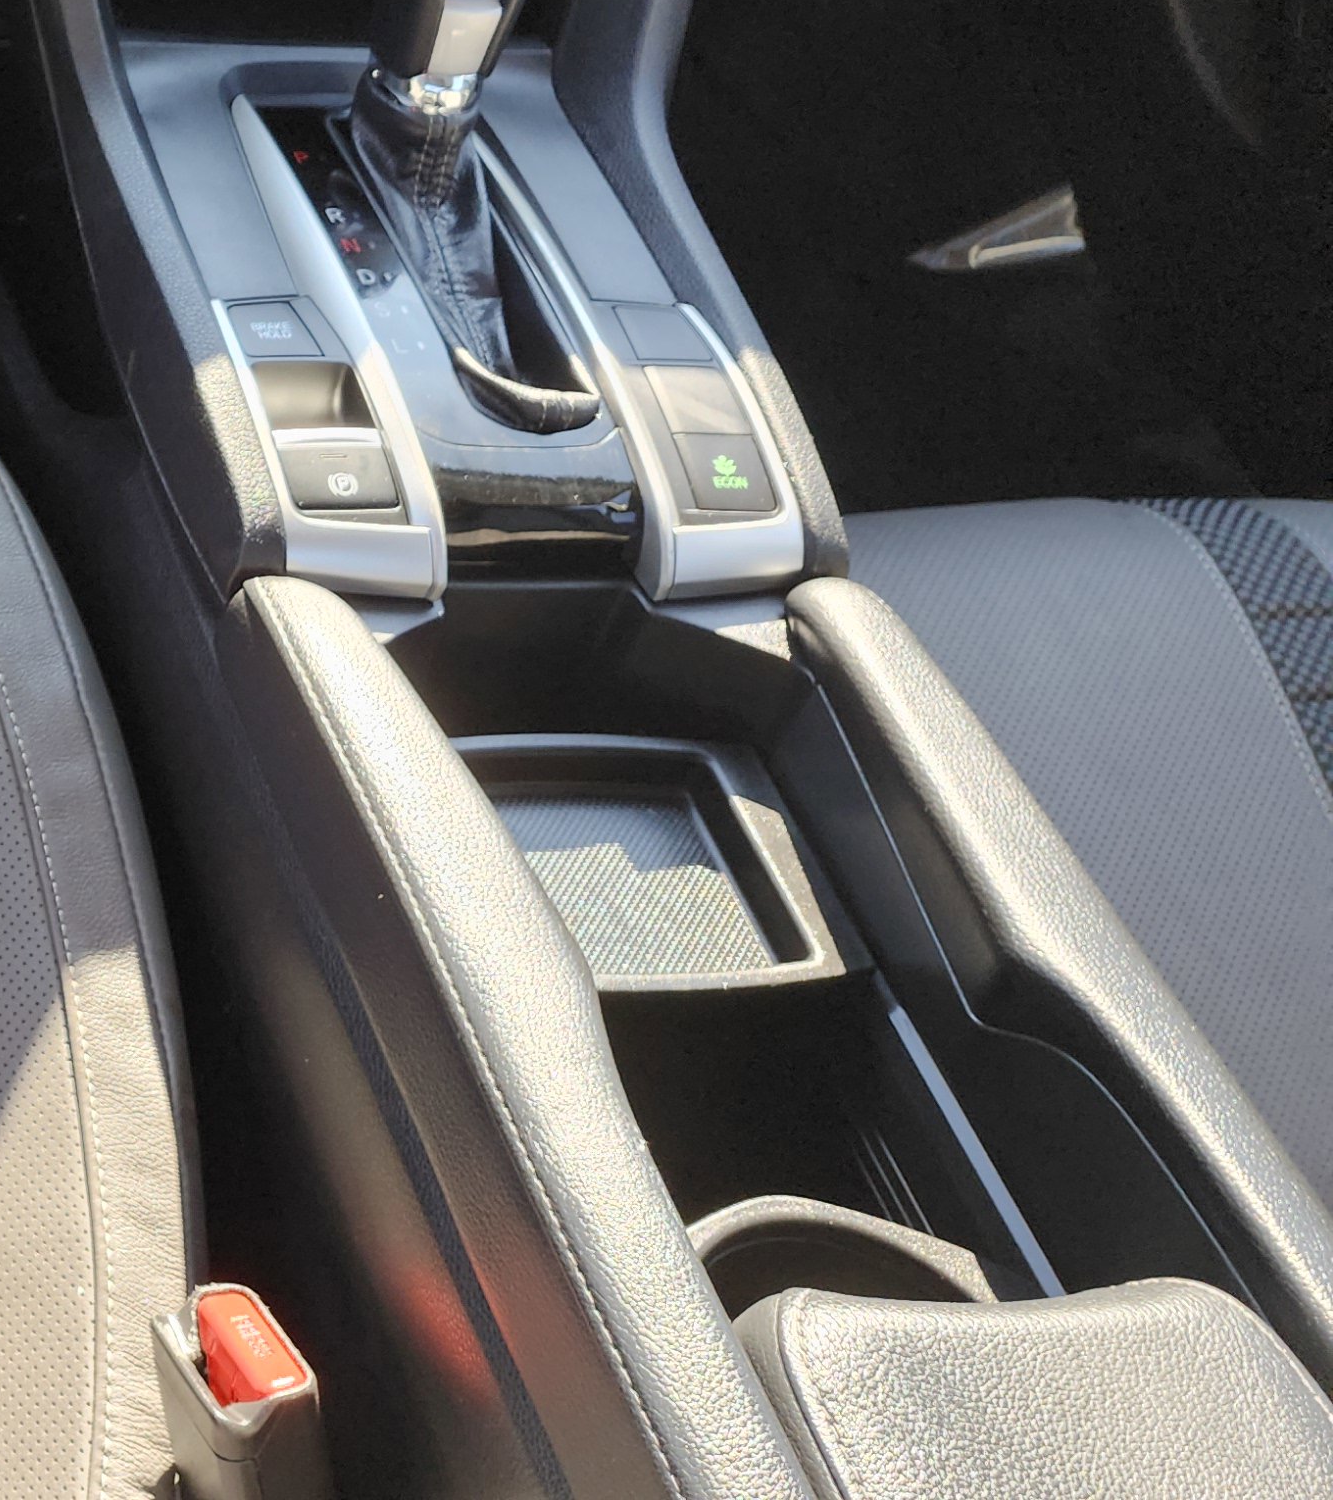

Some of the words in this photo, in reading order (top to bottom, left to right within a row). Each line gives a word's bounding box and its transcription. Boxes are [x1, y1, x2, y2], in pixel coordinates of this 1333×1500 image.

[324, 207, 346, 224] R
[339, 237, 362, 254] N
[356, 268, 376, 286] D
[374, 302, 391, 318] S
[250, 320, 293, 332] BRAKE
[257, 329, 293, 340] HOLD
[392, 338, 409, 354] L
[712, 475, 749, 490] ECON
